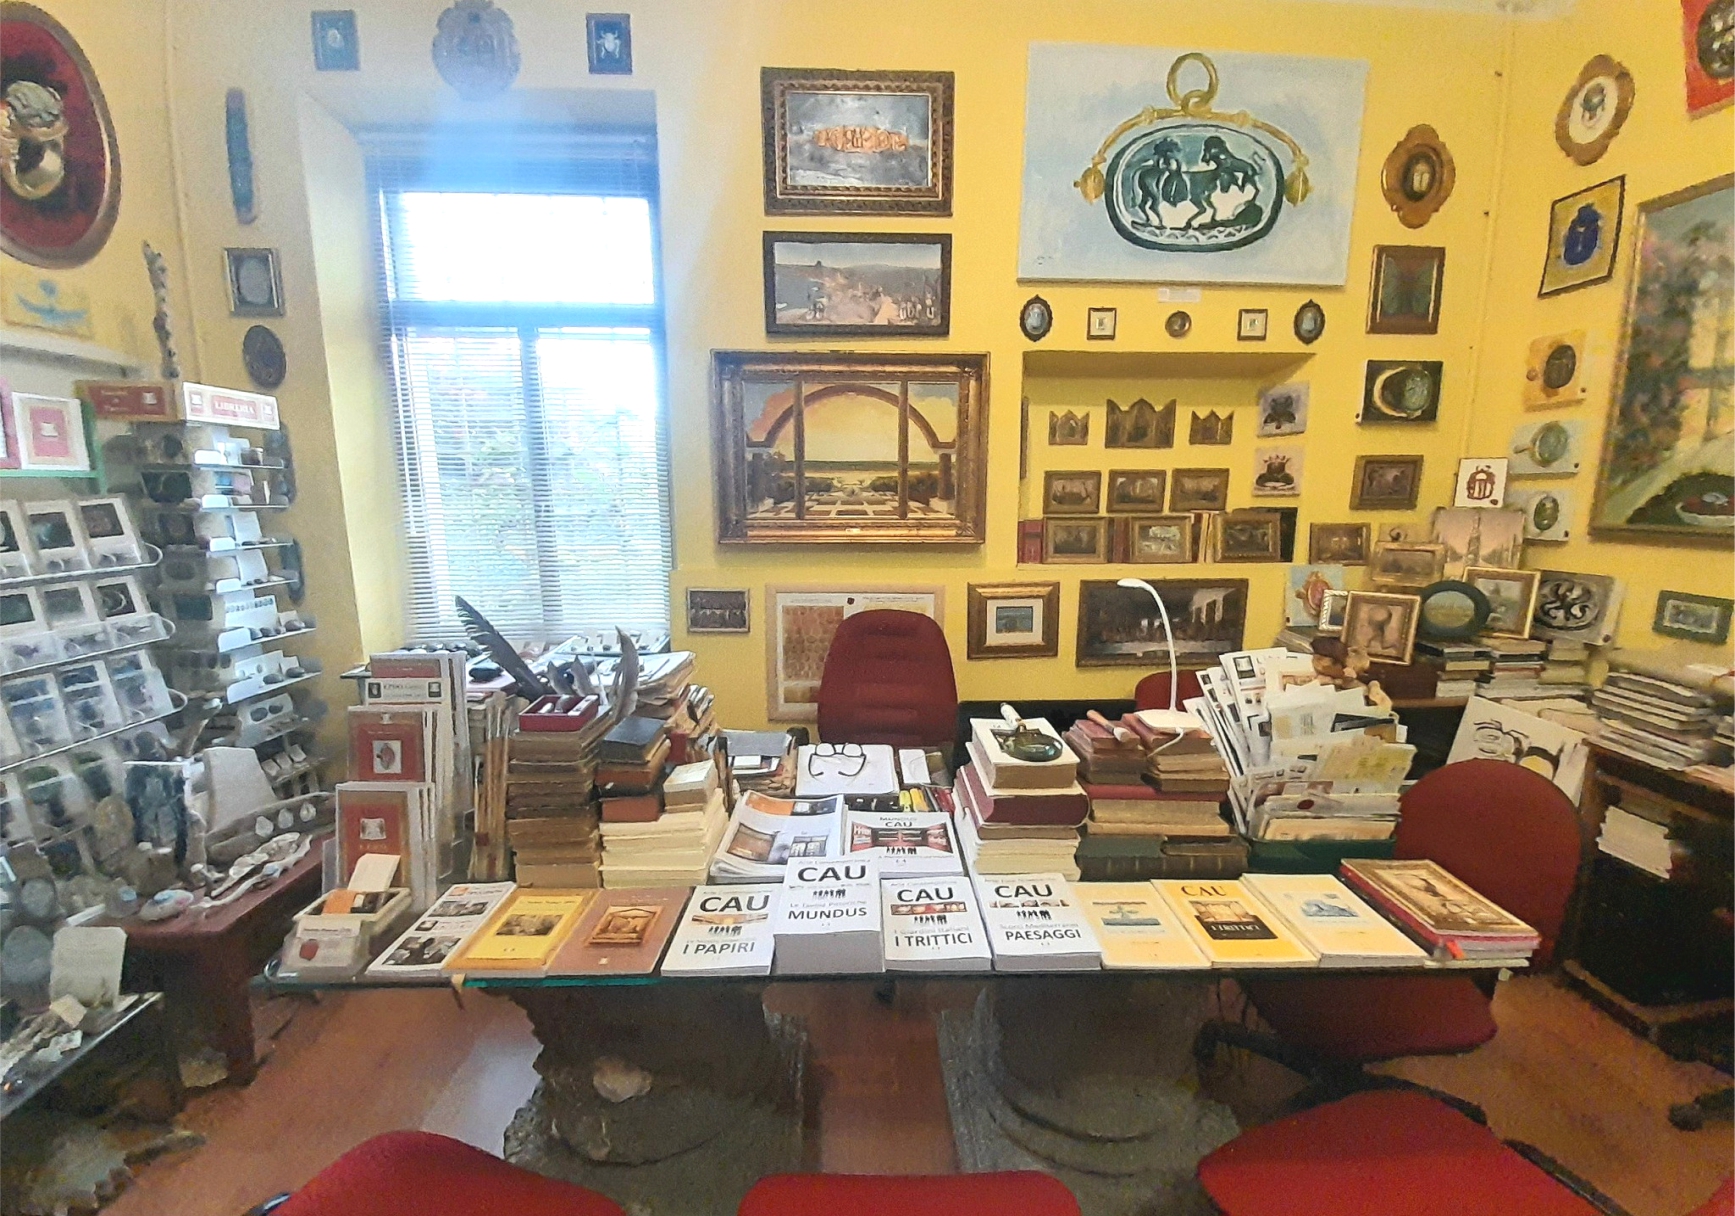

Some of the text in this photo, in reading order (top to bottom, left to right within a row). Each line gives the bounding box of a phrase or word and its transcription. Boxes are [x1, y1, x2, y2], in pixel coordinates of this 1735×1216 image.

[798, 865, 867, 882] CAU
[897, 887, 954, 903] CAU
[994, 884, 1053, 899] CAU
[1181, 885, 1227, 897] CAU
[700, 894, 770, 913] CAU
[788, 907, 867, 920] MUNDUS
[894, 932, 973, 947] I TRITTICI
[1005, 929, 1082, 941] PAESAGGI
[683, 941, 755, 955] I PAPIRI
